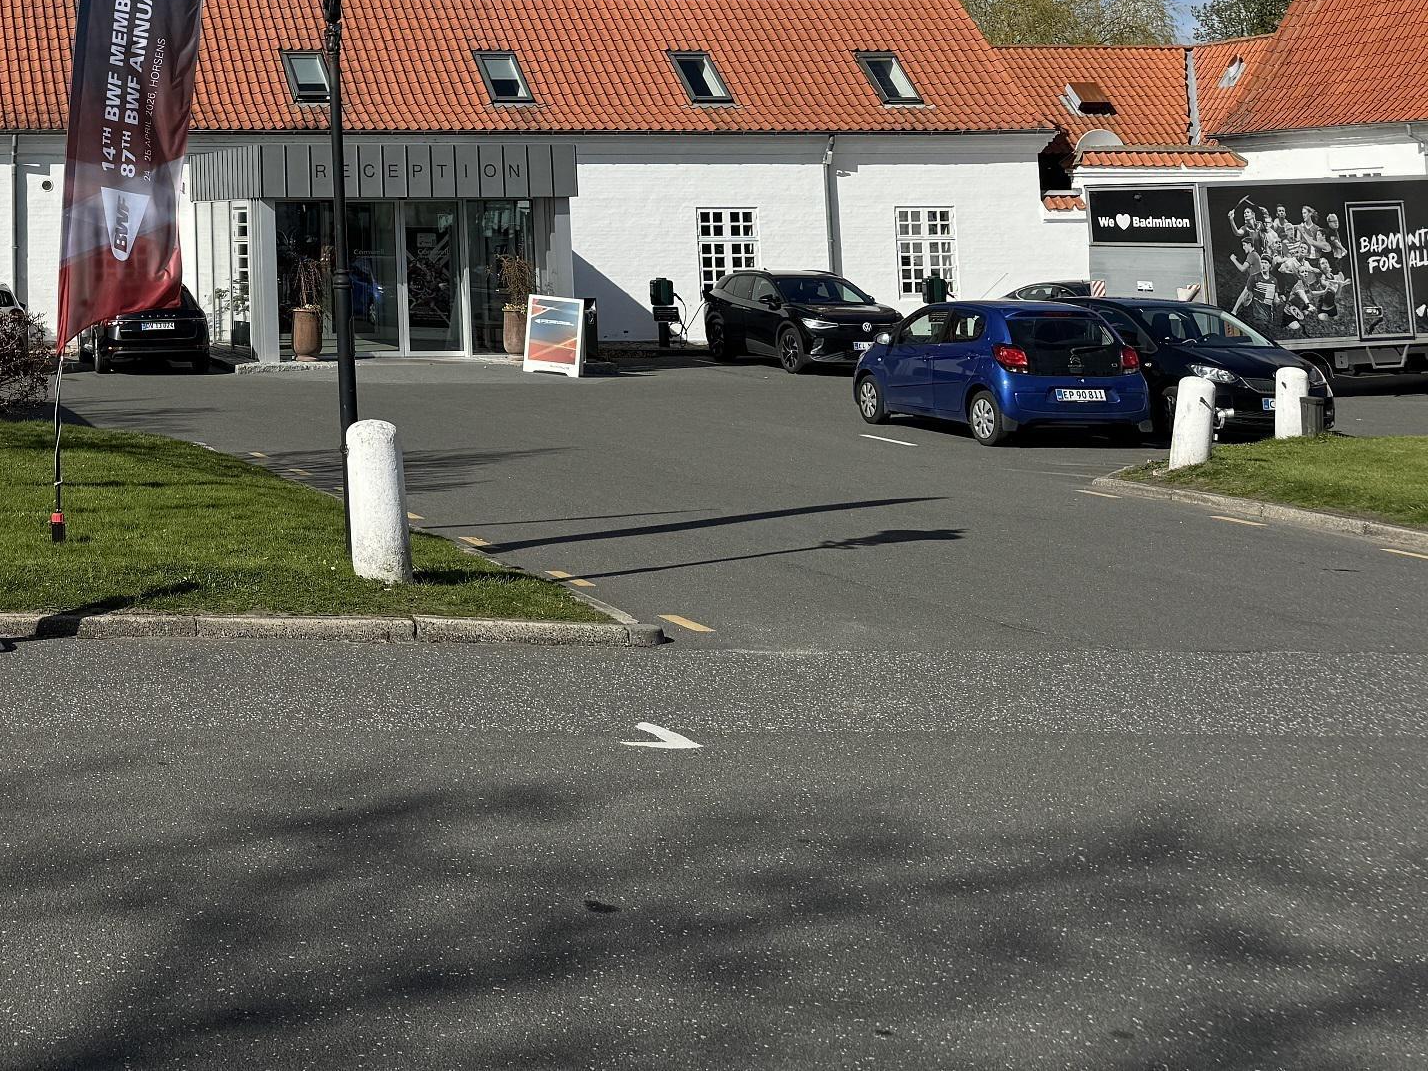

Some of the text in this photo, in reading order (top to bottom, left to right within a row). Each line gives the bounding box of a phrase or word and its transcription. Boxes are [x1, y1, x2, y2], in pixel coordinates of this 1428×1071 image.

[104, 71, 123, 122] BWF
[124, 75, 141, 126] BWF
[144, 119, 152, 148] APRIL
[149, 37, 167, 88] HORSENS
[101, 127, 117, 171] 14TH
[120, 130, 137, 178] 87TH
[315, 163, 521, 178] RECEPTION
[114, 195, 130, 254] BWF
[1098, 216, 1190, 227] We Badminton
[1367, 252, 1401, 274] FOR
[1063, 390, 1104, 399] EP 90 811
